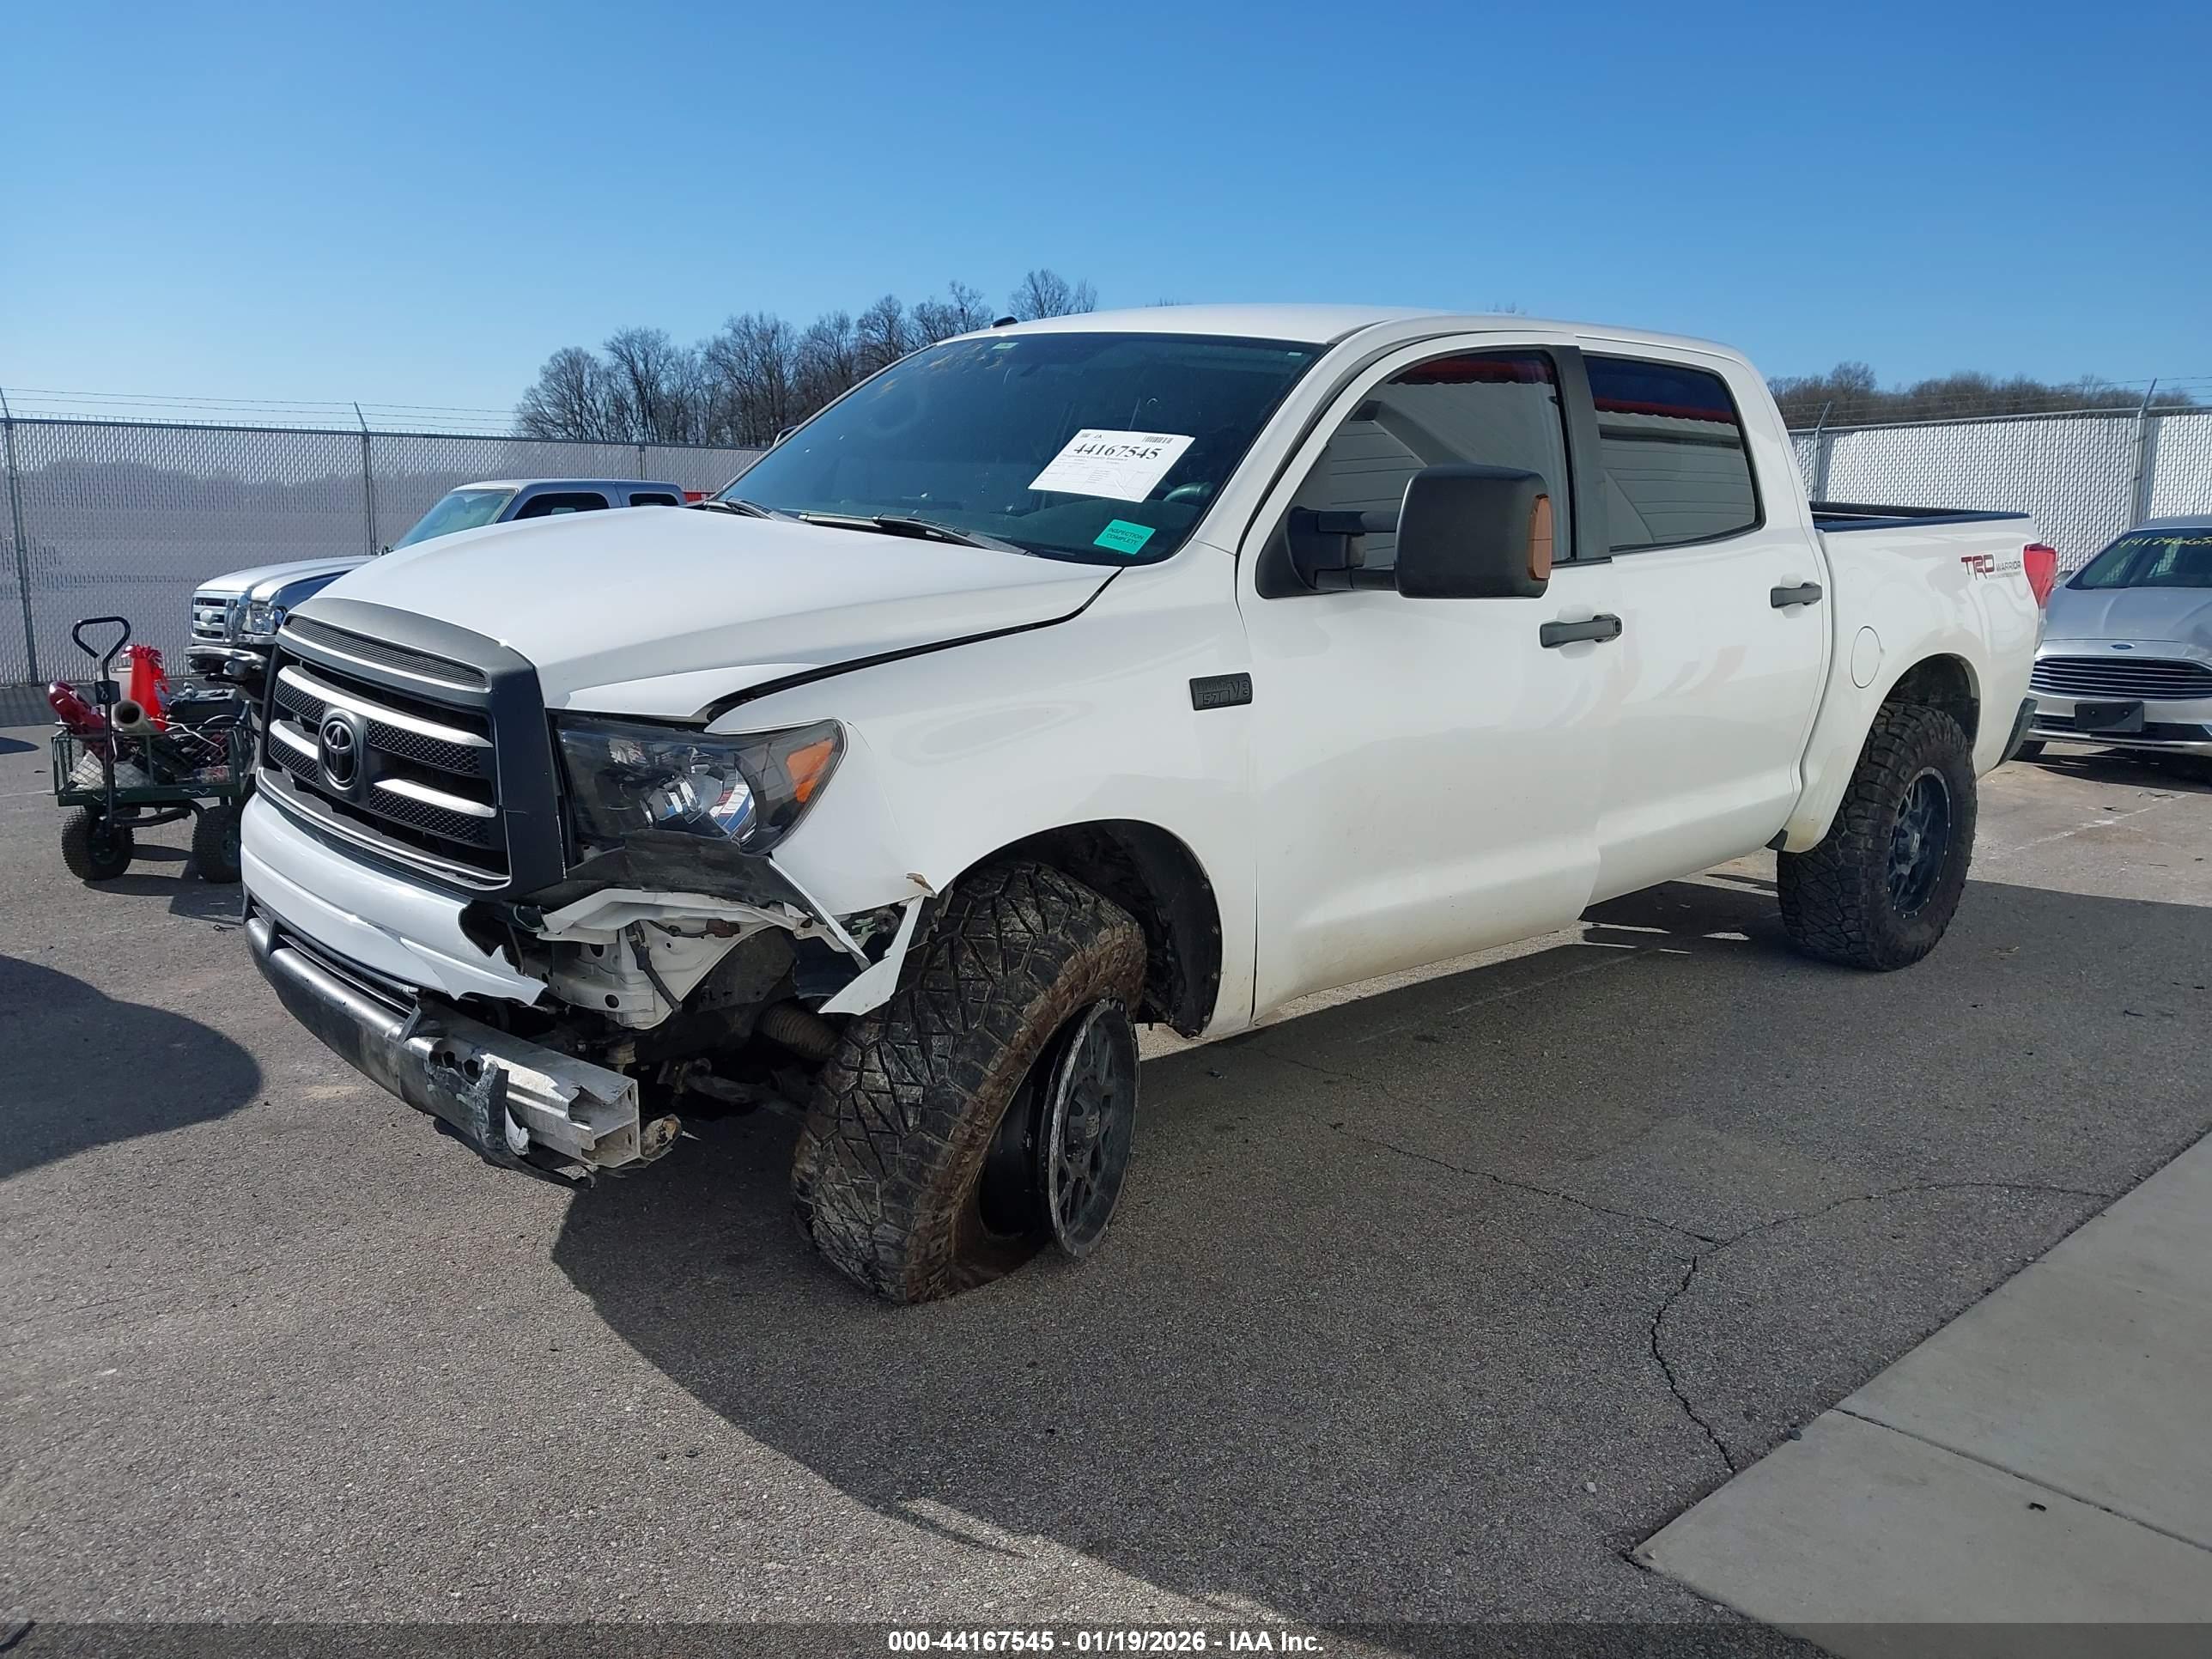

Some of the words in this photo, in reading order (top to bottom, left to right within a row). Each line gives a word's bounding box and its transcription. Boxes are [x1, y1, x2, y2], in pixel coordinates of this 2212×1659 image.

[1073, 442, 1164, 460] 44167545
[1106, 532, 1139, 545] COMPLETE
[1108, 527, 1145, 540] INSPECTION
[1961, 555, 1995, 580] TRD
[1996, 560, 2021, 571] WARRIOR
